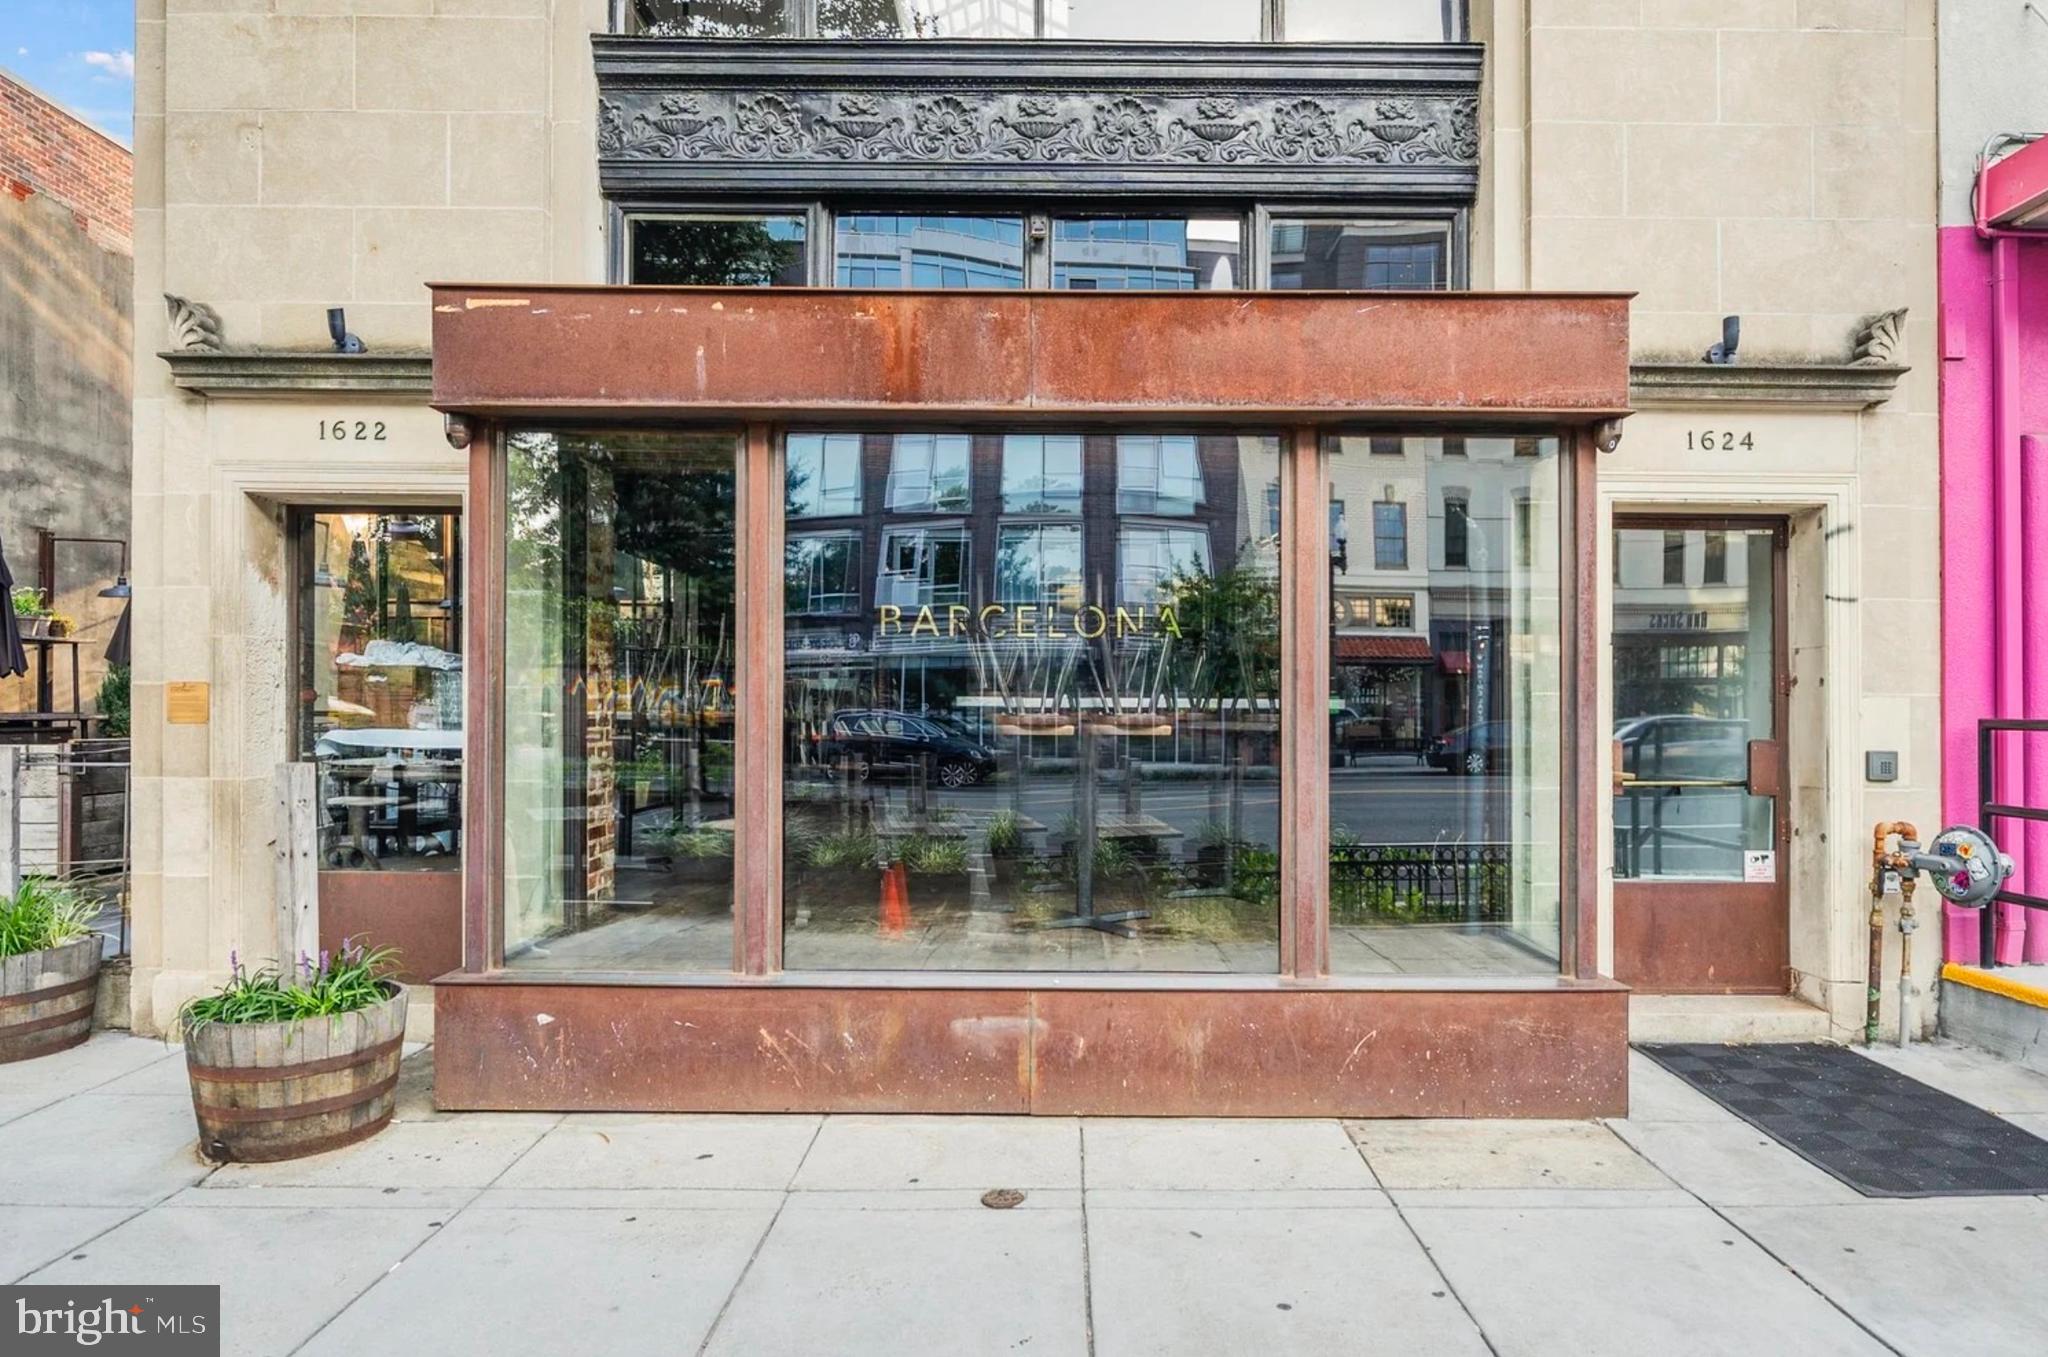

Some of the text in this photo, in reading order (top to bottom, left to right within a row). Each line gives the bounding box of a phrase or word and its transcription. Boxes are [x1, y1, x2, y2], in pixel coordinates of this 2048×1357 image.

[319, 420, 387, 441] 1622
[1687, 429, 1754, 451] 1624
[879, 604, 1183, 640] BARCELONA
